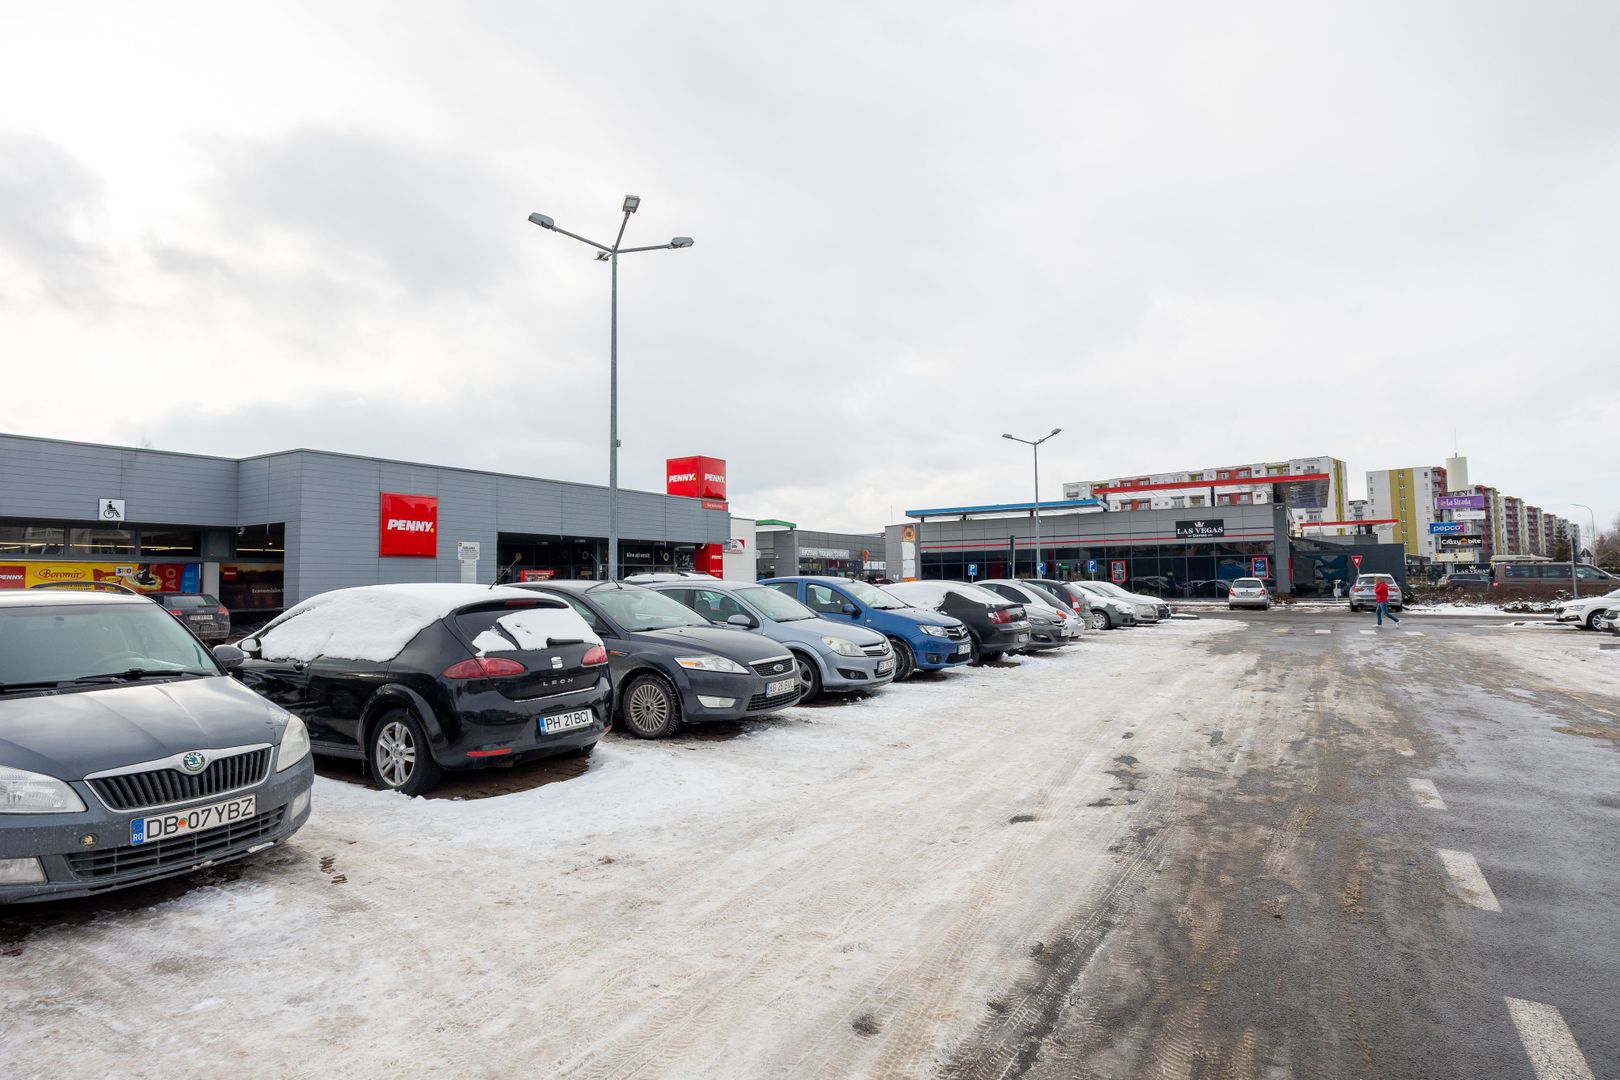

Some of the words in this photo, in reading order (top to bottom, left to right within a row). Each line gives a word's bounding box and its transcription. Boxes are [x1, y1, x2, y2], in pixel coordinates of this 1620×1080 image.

[668, 473, 697, 483] PENNY.
[387, 519, 435, 533] PENNY.
[1195, 526, 1223, 534] VEGAS
[38, 568, 82, 579] Boromir
[543, 678, 574, 687] LEON
[545, 716, 561, 730] PH
[146, 815, 179, 839] DB
[133, 832, 143, 841] RO
